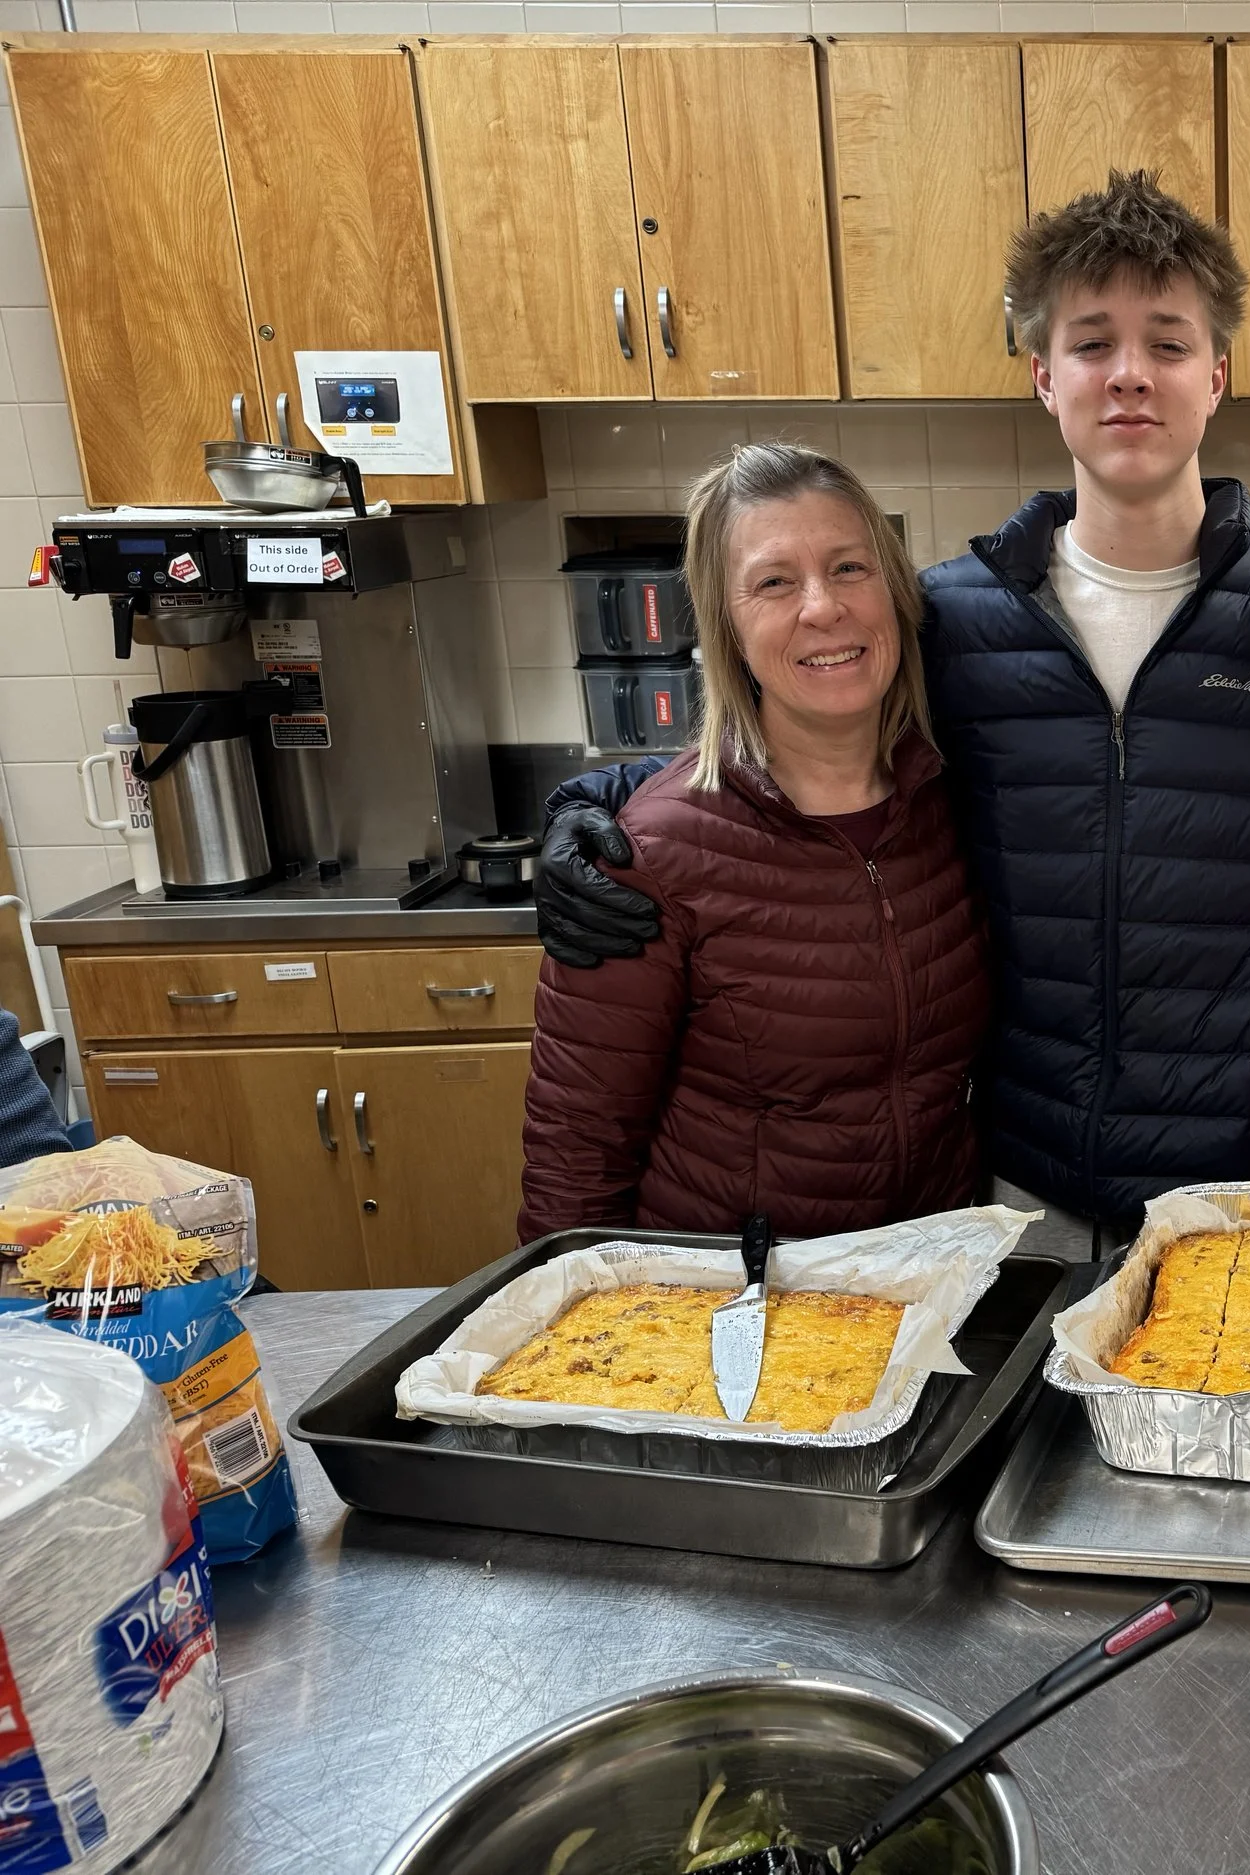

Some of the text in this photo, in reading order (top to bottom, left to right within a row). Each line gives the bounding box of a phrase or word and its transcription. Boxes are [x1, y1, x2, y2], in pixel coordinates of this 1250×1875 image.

[260, 545, 308, 555] This side
[249, 563, 319, 574] Out of Order
[647, 589, 658, 638] CAFFEINATED
[1198, 673, 1242, 690] Eddie
[659, 697, 668, 721] DECAF
[178, 1230, 195, 1239] ITM.
[199, 1227, 213, 1236] ART.
[213, 1222, 235, 1233] 22106
[0, 1244, 23, 1253] RATED
[53, 1286, 143, 1309] KIRKLAND
[182, 1353, 229, 1388] Gluten-Free
[144, 1604, 209, 1673] ULTR
